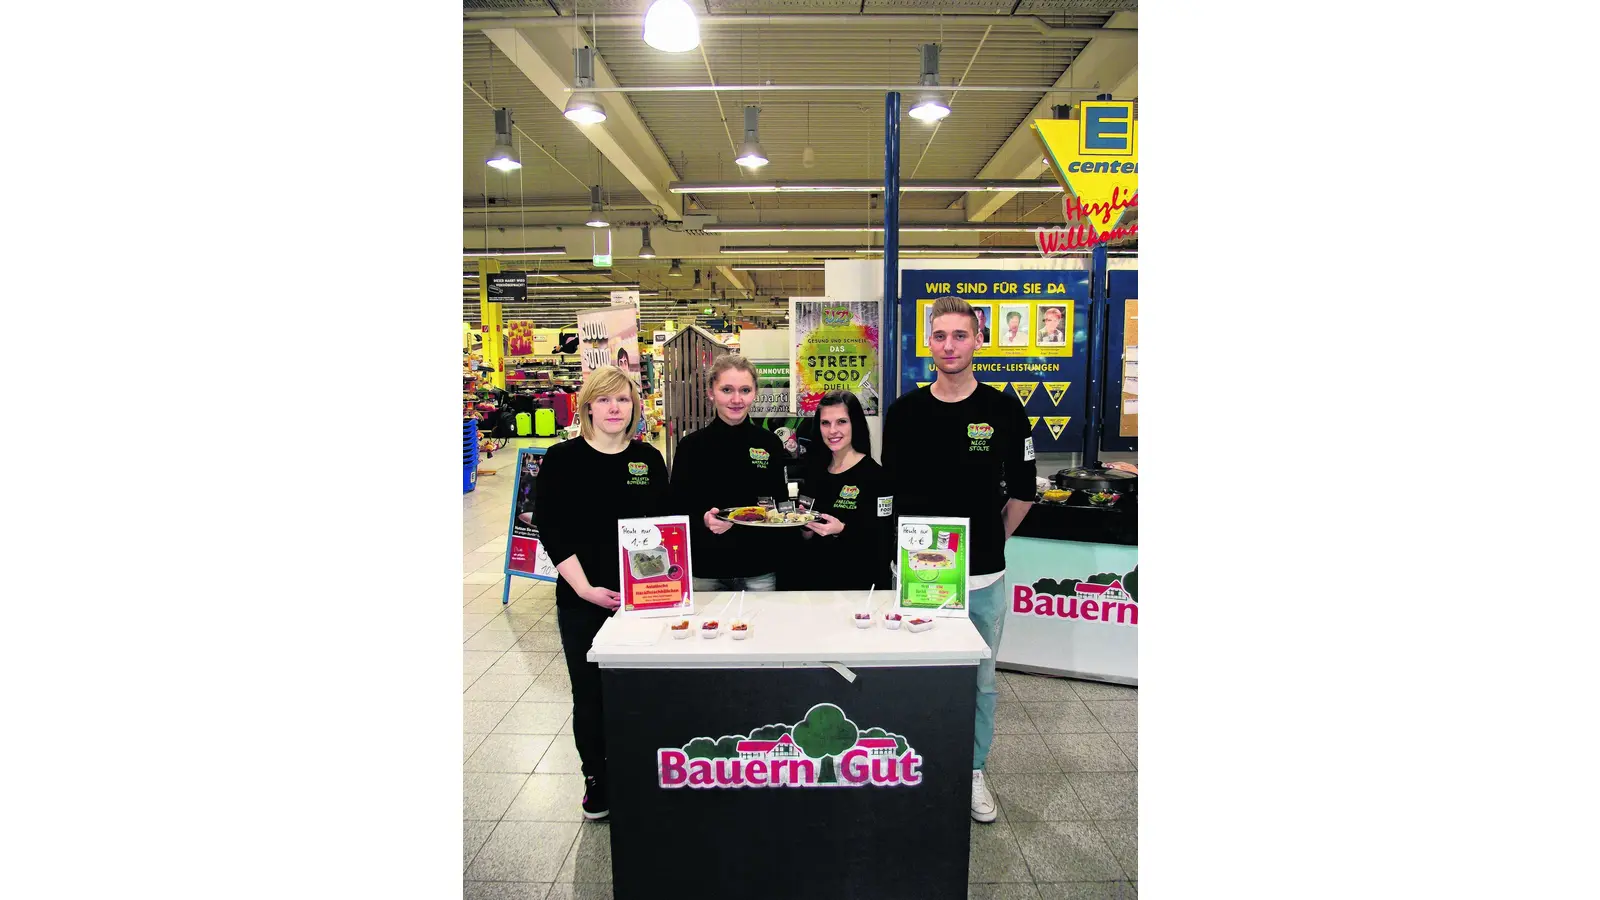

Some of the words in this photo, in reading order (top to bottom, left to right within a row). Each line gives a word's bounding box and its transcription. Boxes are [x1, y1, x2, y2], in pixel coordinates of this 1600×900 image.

[1086, 107, 1128, 149] E
[1068, 160, 1138, 174] cente
[925, 282, 950, 294] WIR
[956, 282, 987, 294] SIND
[993, 281, 1018, 294] FÜR
[1023, 282, 1041, 294] SIE
[1047, 282, 1066, 294] DA
[807, 355, 867, 368] STREET
[972, 363, 1060, 372] ERVICE-LEISTUNGEN
[814, 369, 860, 381] FOOD
[823, 383, 851, 391] DUELL
[754, 392, 790, 402] anarti
[1013, 585, 1138, 625] Bauern
[660, 750, 814, 785] Bauern
[840, 749, 919, 784] Gut
